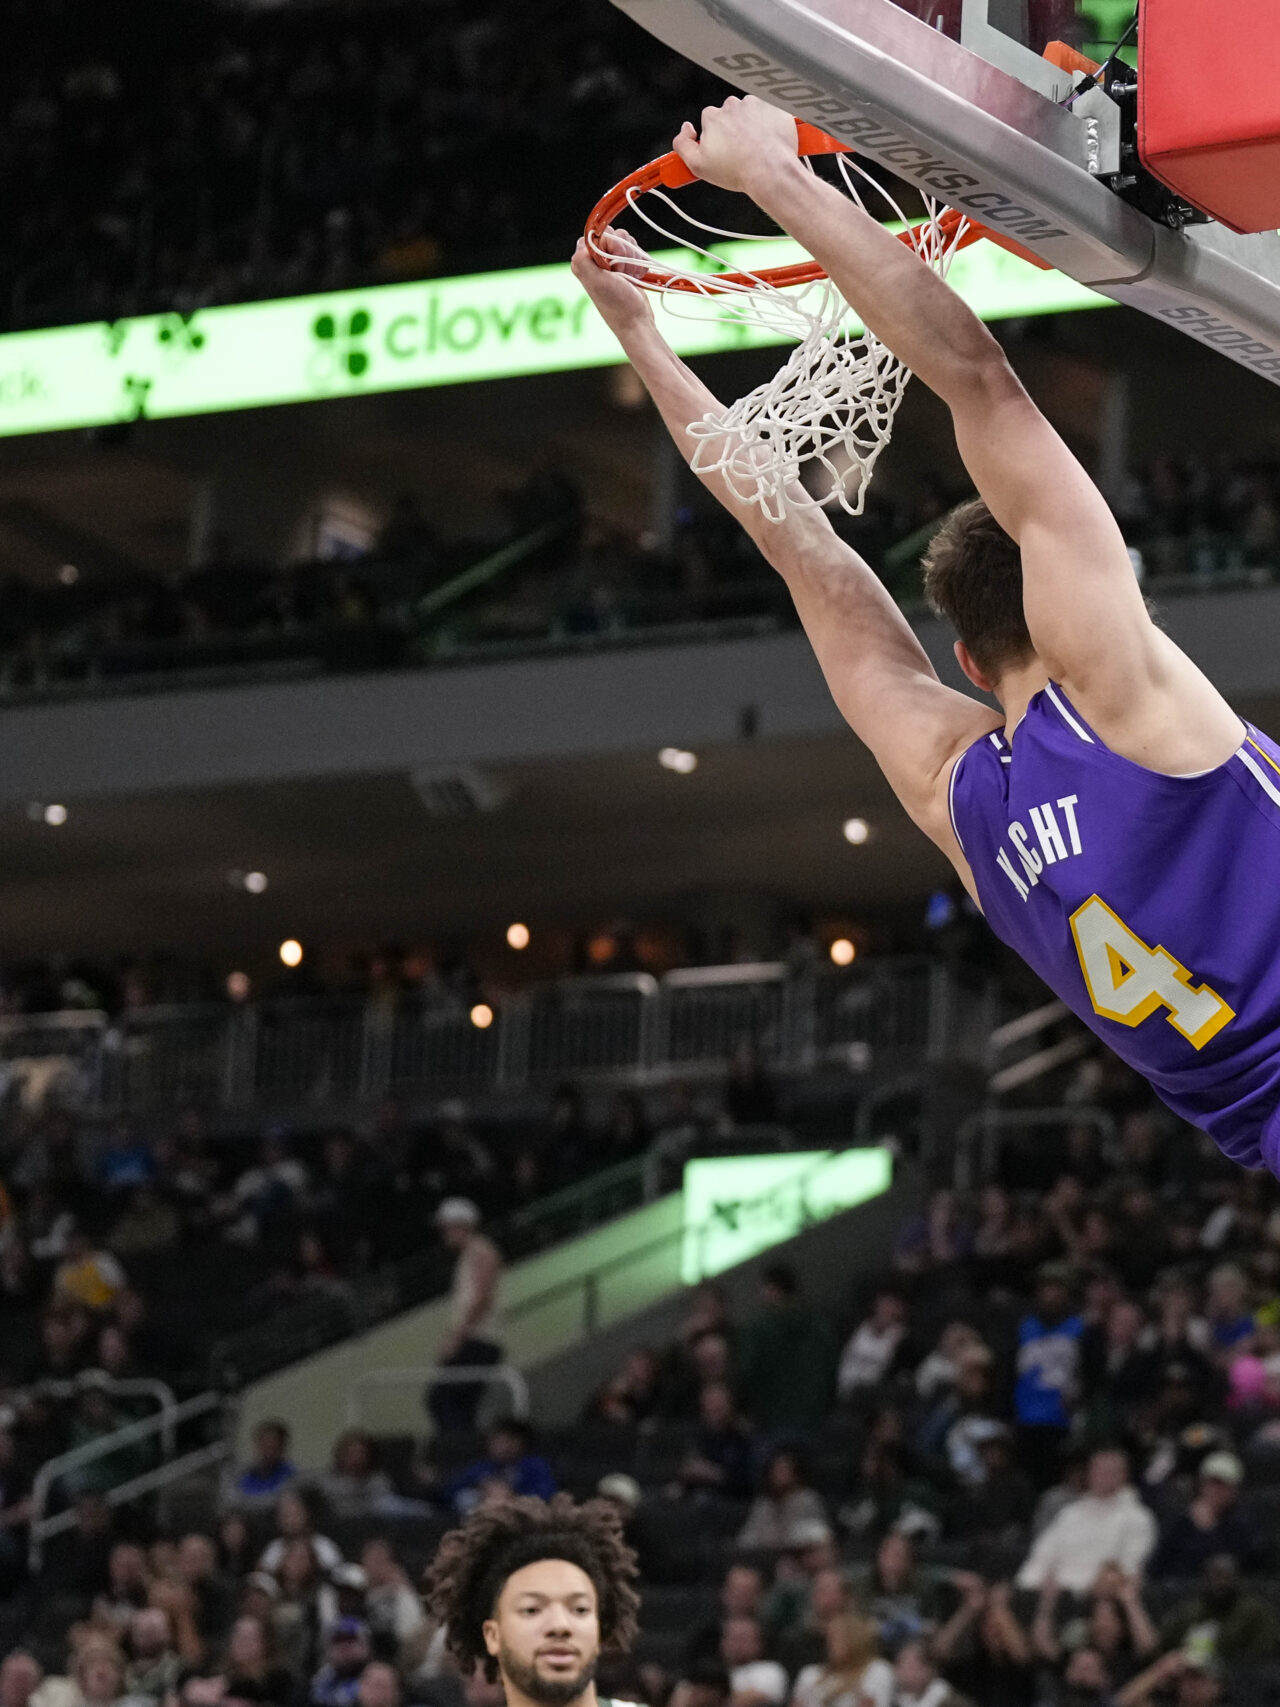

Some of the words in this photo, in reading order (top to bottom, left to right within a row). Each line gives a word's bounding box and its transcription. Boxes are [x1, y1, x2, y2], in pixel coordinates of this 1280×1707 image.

[713, 52, 1071, 242] SHOP.BUCKS.COM
[384, 291, 591, 362] clover
[1069, 893, 1236, 1052] 4
